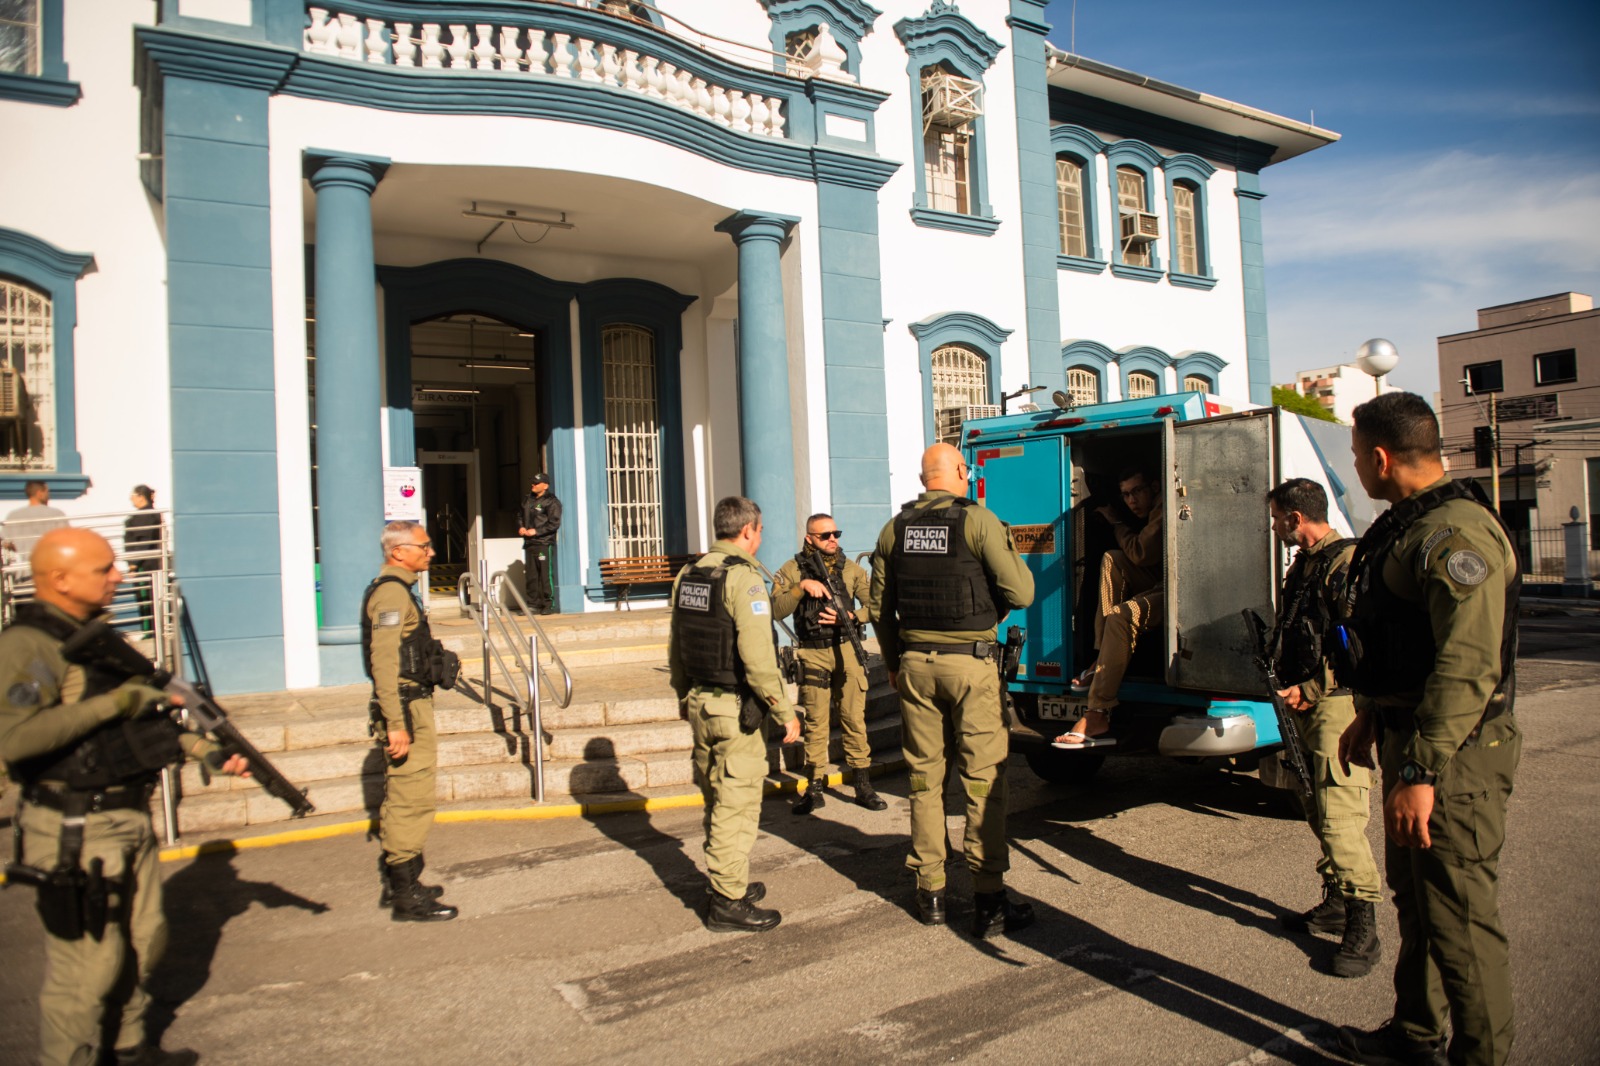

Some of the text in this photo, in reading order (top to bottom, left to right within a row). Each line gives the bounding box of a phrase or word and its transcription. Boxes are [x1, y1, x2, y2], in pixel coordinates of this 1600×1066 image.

[412, 393, 480, 402] VEIRA COSTA
[907, 527, 946, 539] POLÍCIA
[906, 539, 946, 550] PENAL
[680, 595, 708, 608] PENAL
